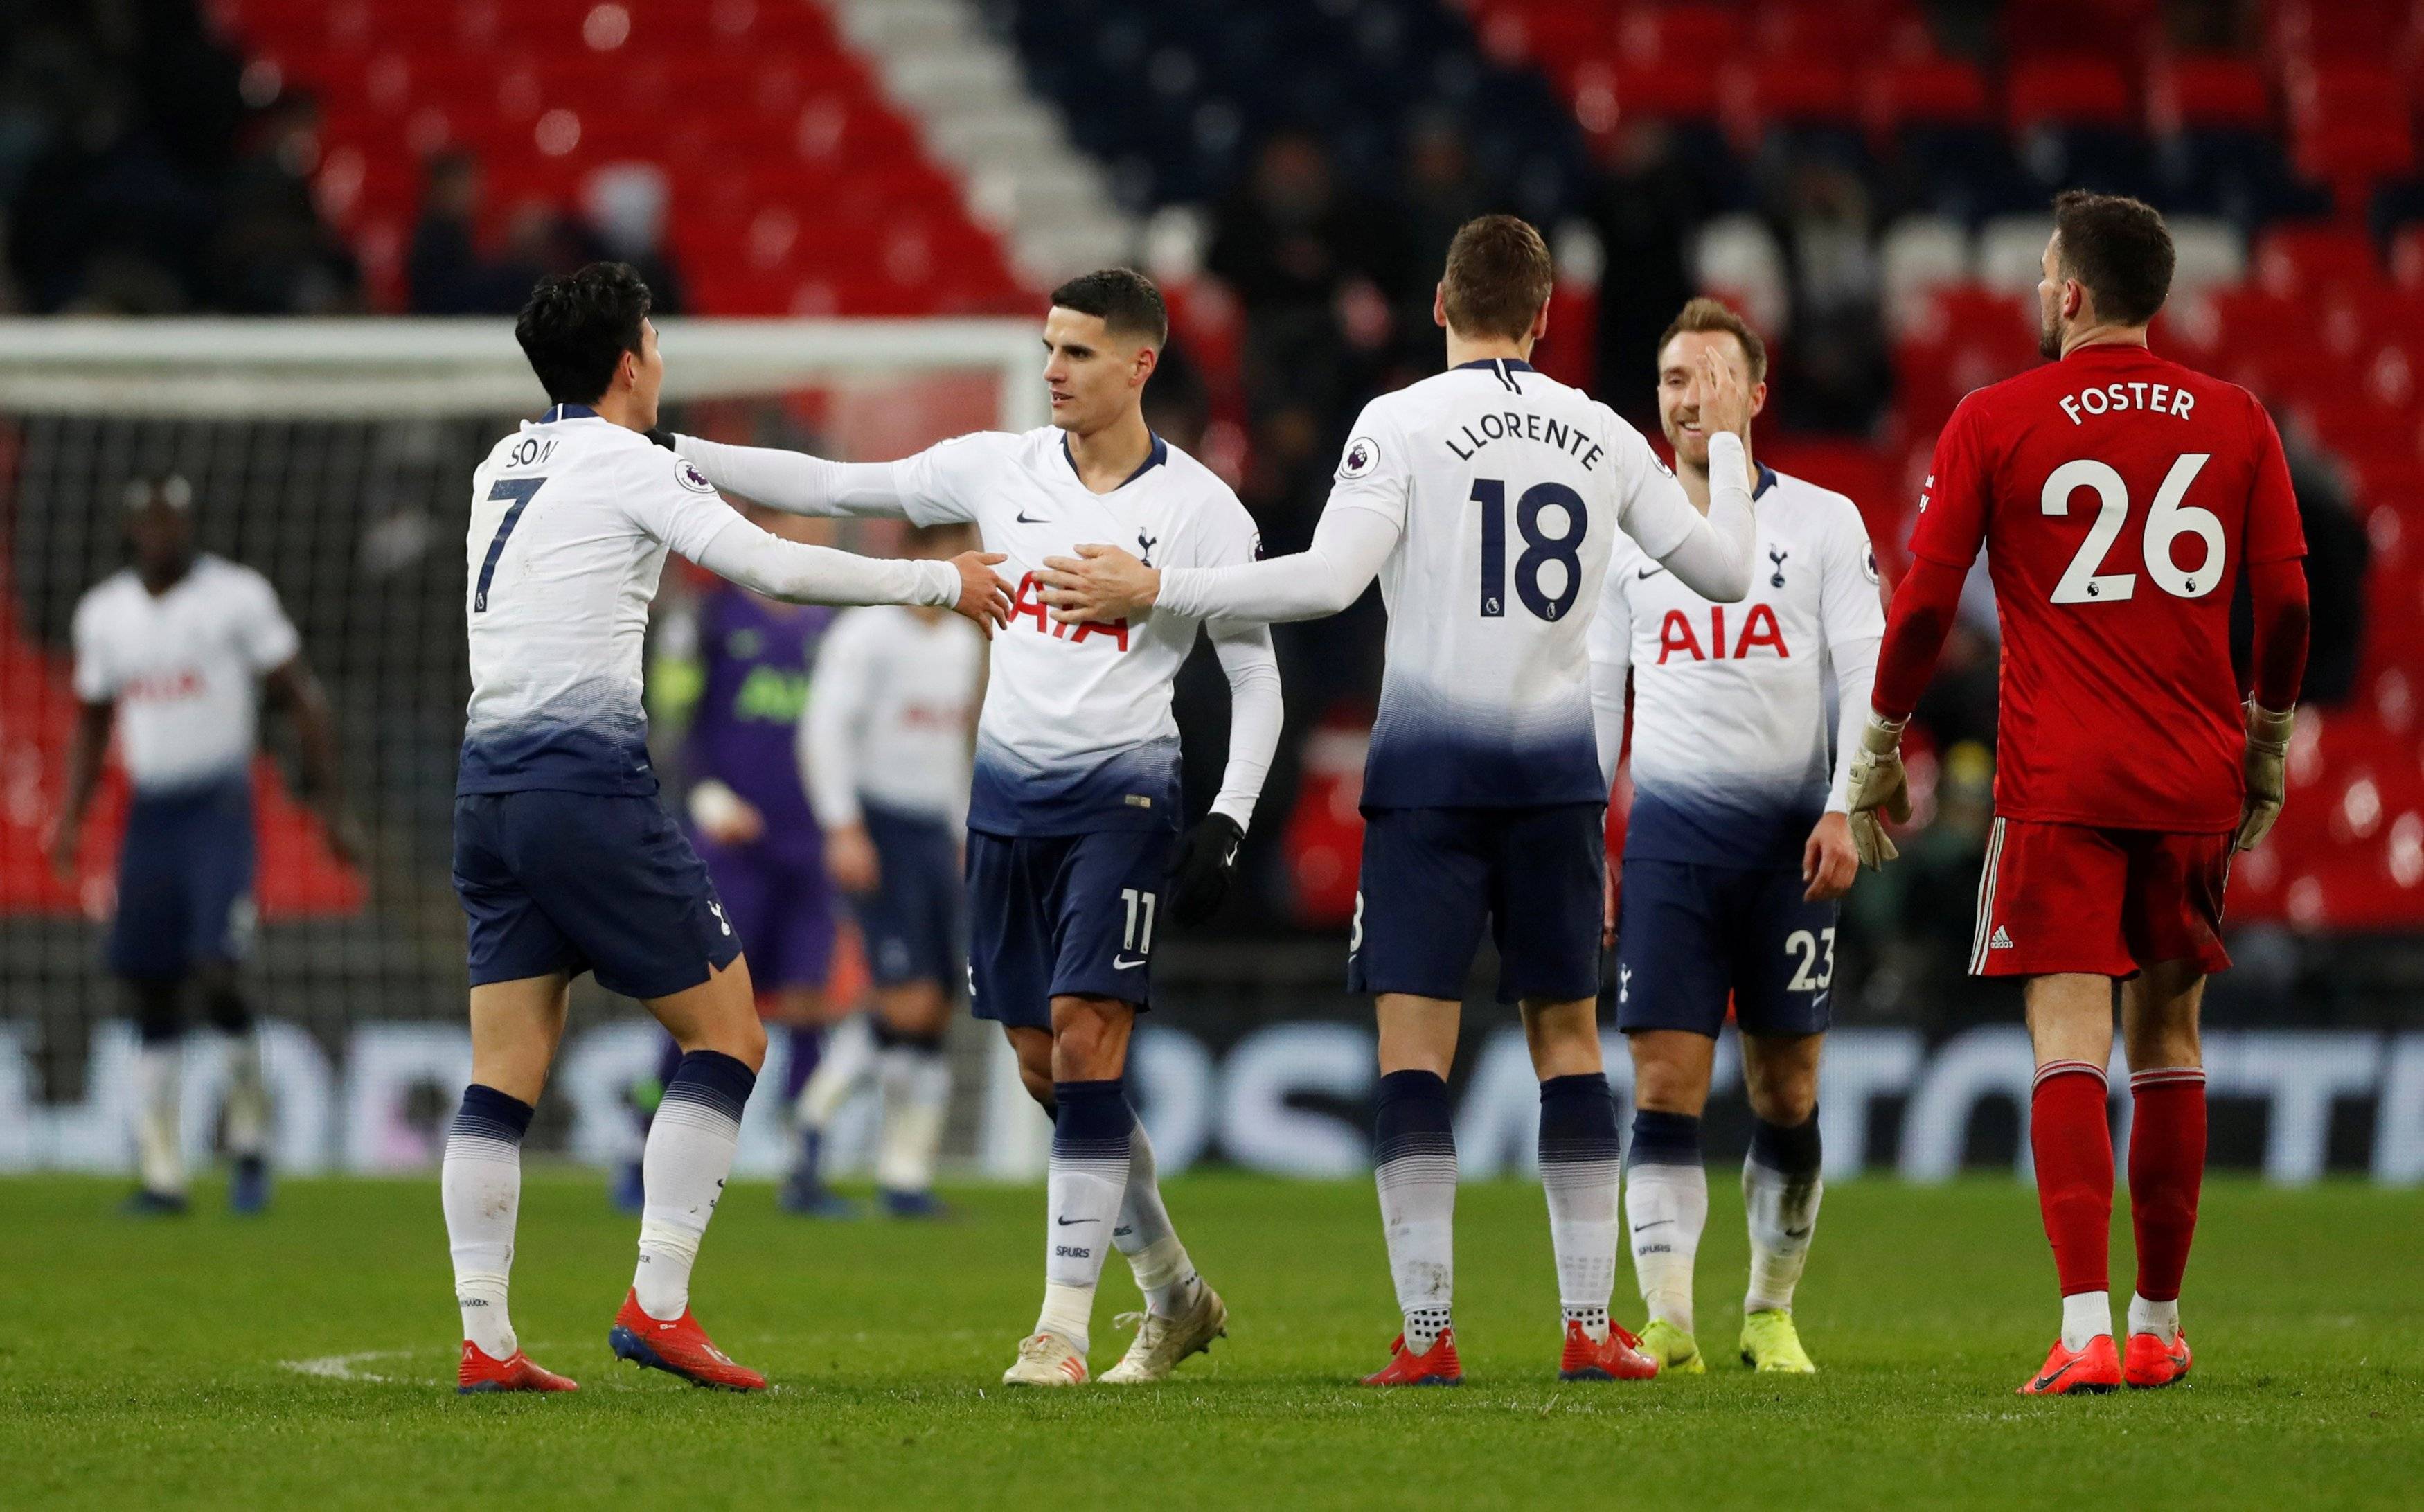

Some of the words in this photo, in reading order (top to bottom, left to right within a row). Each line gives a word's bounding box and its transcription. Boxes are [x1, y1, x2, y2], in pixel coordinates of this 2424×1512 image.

[2059, 382, 2195, 425] FOSTER
[506, 438, 560, 468] SON
[1445, 411, 1605, 472] LLORENTE
[474, 477, 548, 613] 7
[1470, 477, 1588, 622] 18
[2040, 452, 2227, 604] 26
[1655, 603, 1790, 665] AIA
[1121, 887, 1156, 955] 11
[1785, 927, 1835, 991] 23
[1056, 1245, 1090, 1258] SPURS
